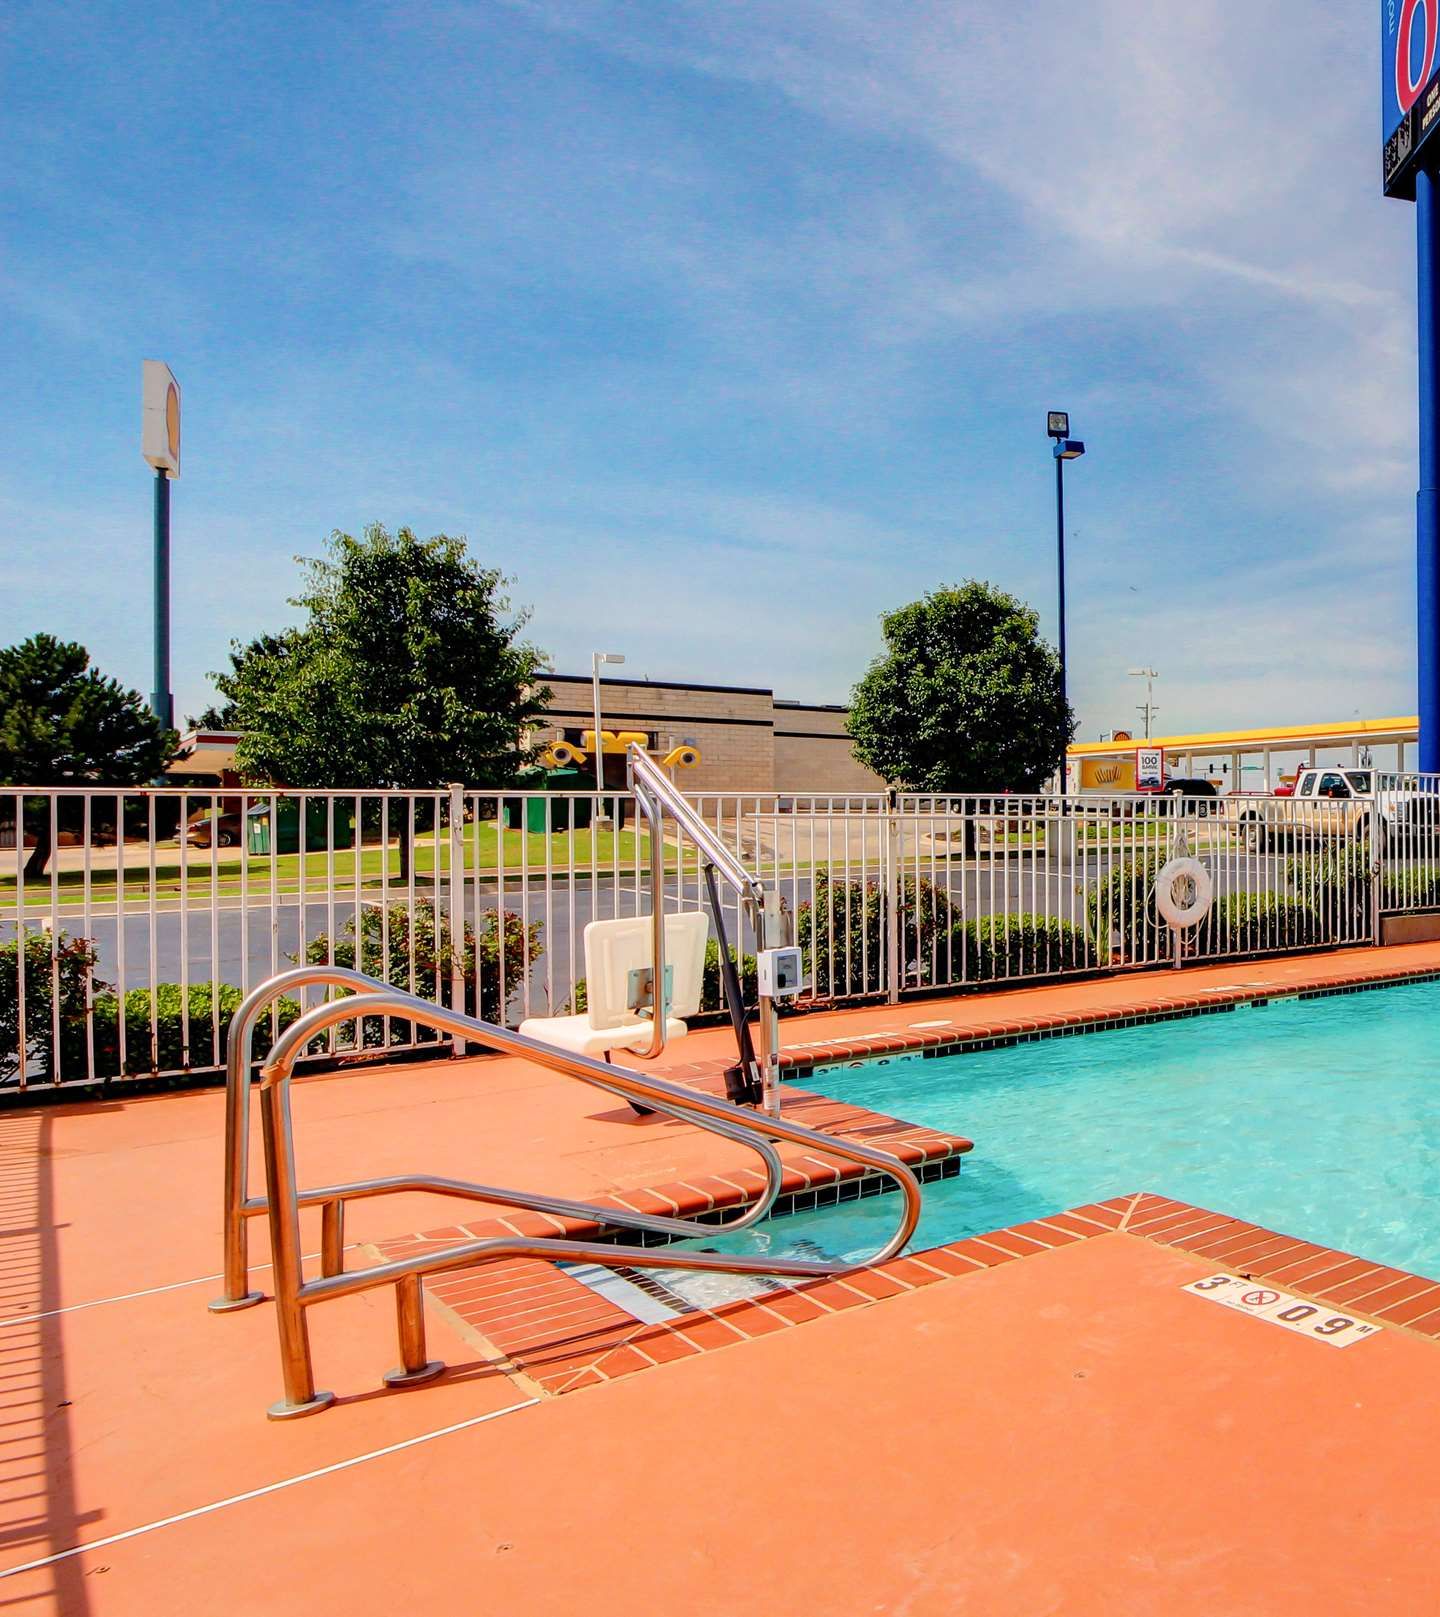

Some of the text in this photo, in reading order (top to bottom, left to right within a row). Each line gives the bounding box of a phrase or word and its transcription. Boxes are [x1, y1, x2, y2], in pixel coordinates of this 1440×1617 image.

[1426, 82, 1440, 107] ONE
[1141, 756, 1157, 765] 100
[1194, 1277, 1231, 1290] 3
[1229, 1281, 1248, 1289] FT
[1355, 1325, 1373, 1334] M
